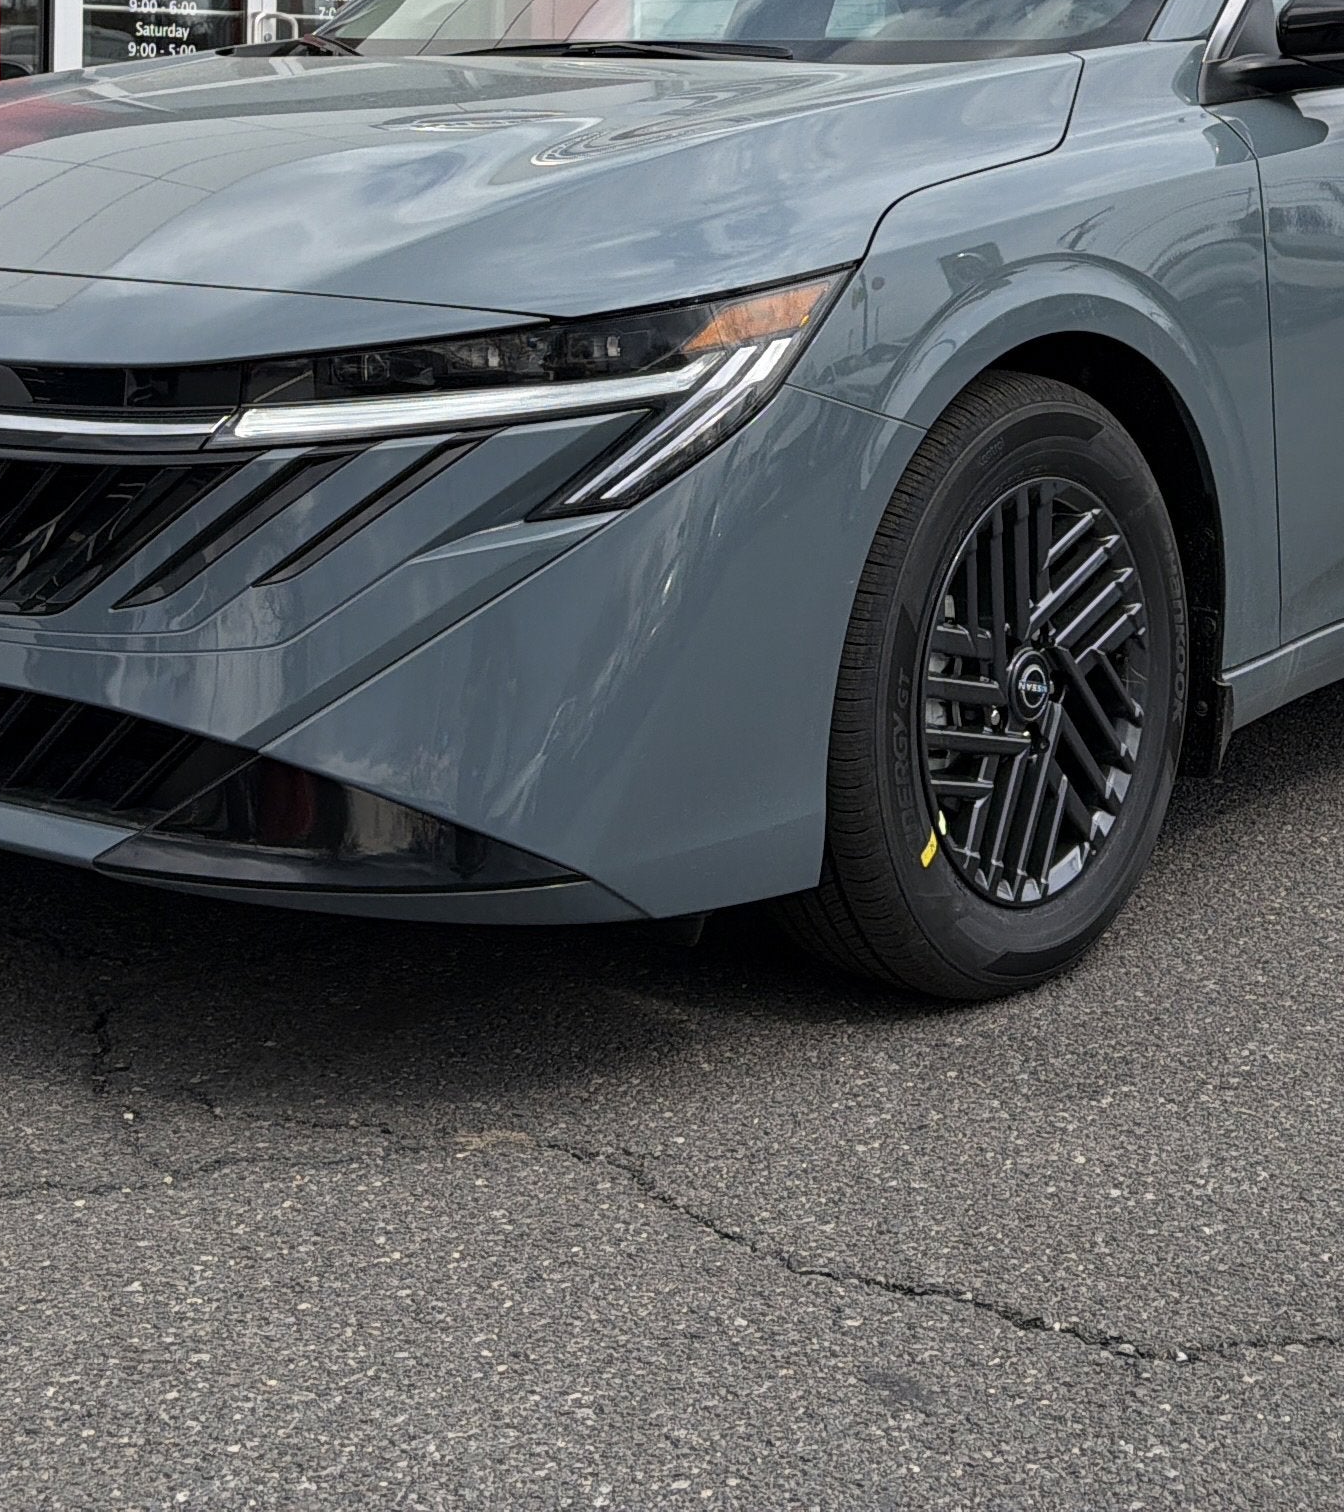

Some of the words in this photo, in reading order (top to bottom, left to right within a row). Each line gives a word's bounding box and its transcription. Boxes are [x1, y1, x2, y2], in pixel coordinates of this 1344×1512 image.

[169, 1, 197, 16] 6:00
[135, 21, 190, 41] Saturday
[127, 42, 157, 58] 9:00
[168, 44, 196, 56] 5:00
